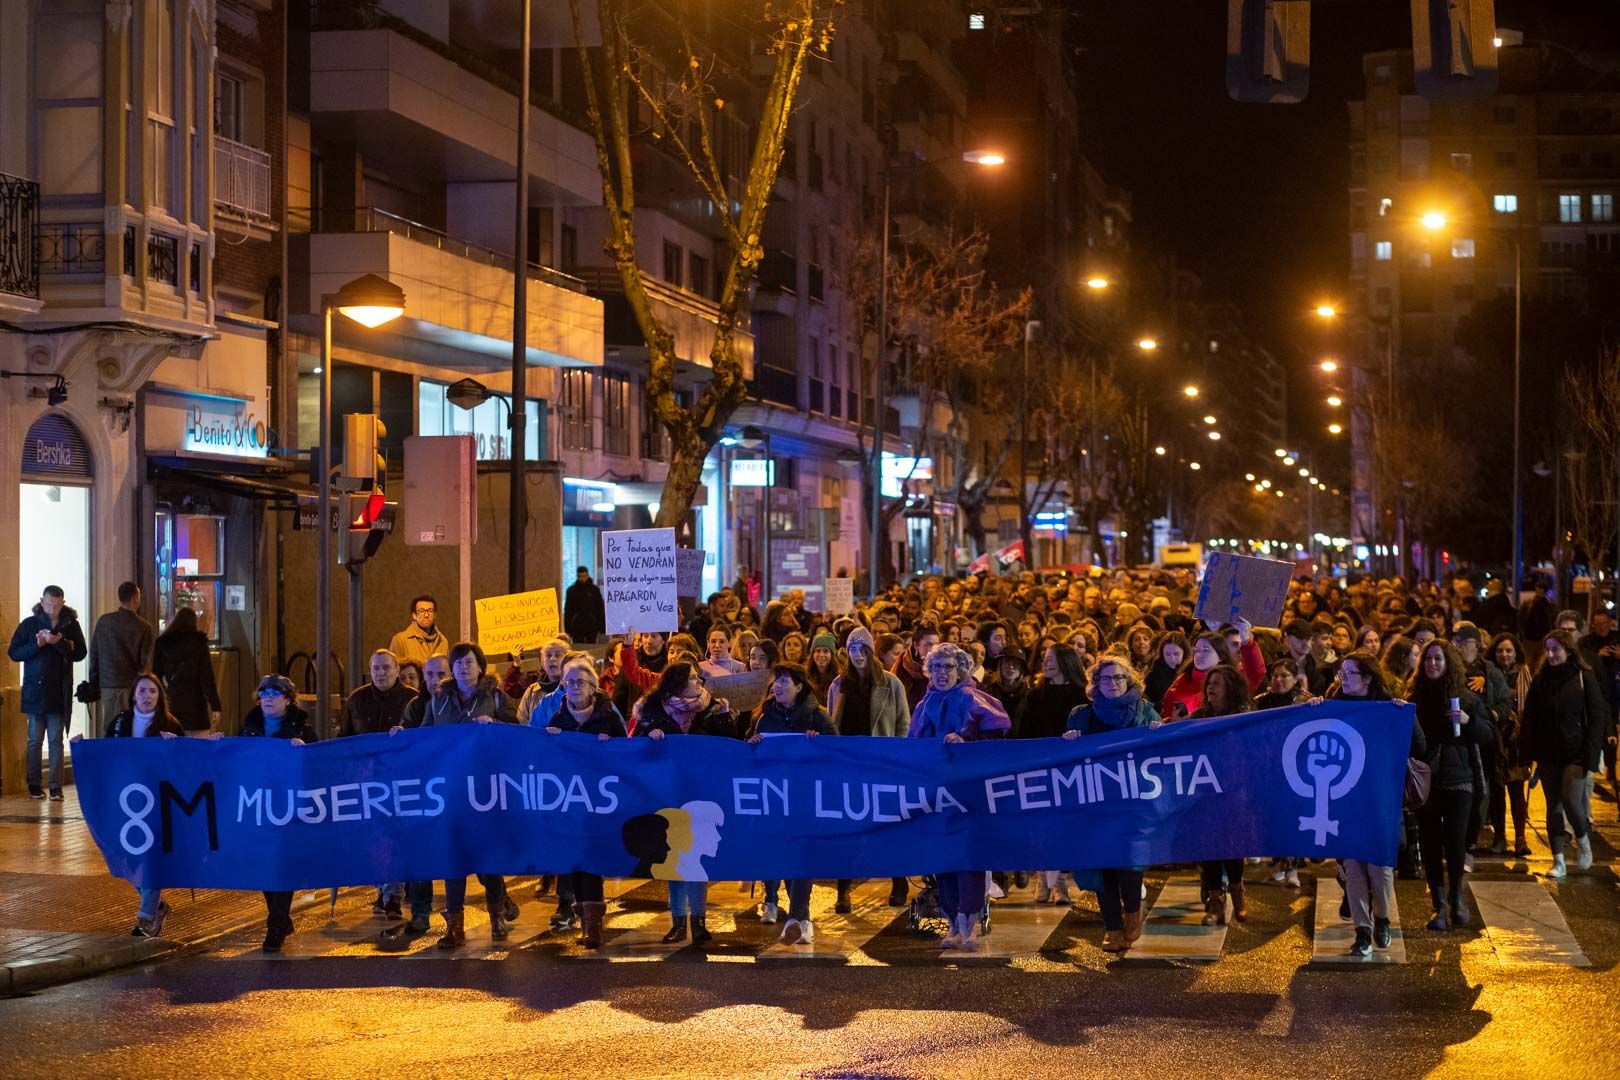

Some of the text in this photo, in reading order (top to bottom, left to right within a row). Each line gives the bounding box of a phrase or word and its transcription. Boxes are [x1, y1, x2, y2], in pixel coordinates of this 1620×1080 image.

[193, 404, 231, 446] Benito
[235, 412, 246, 447] &
[37, 440, 71, 465] Bershka
[607, 537, 621, 553] Por
[656, 546, 671, 557] que
[606, 556, 675, 570] NO VENDRAN
[607, 575, 626, 587] pues
[628, 574, 638, 583] de
[607, 590, 657, 603] APAGARON
[640, 601, 675, 613] su Voz
[119, 780, 219, 855] 8M
[237, 777, 446, 826] MUJERES
[732, 777, 789, 816] EN
[815, 779, 968, 823] LUCHA
